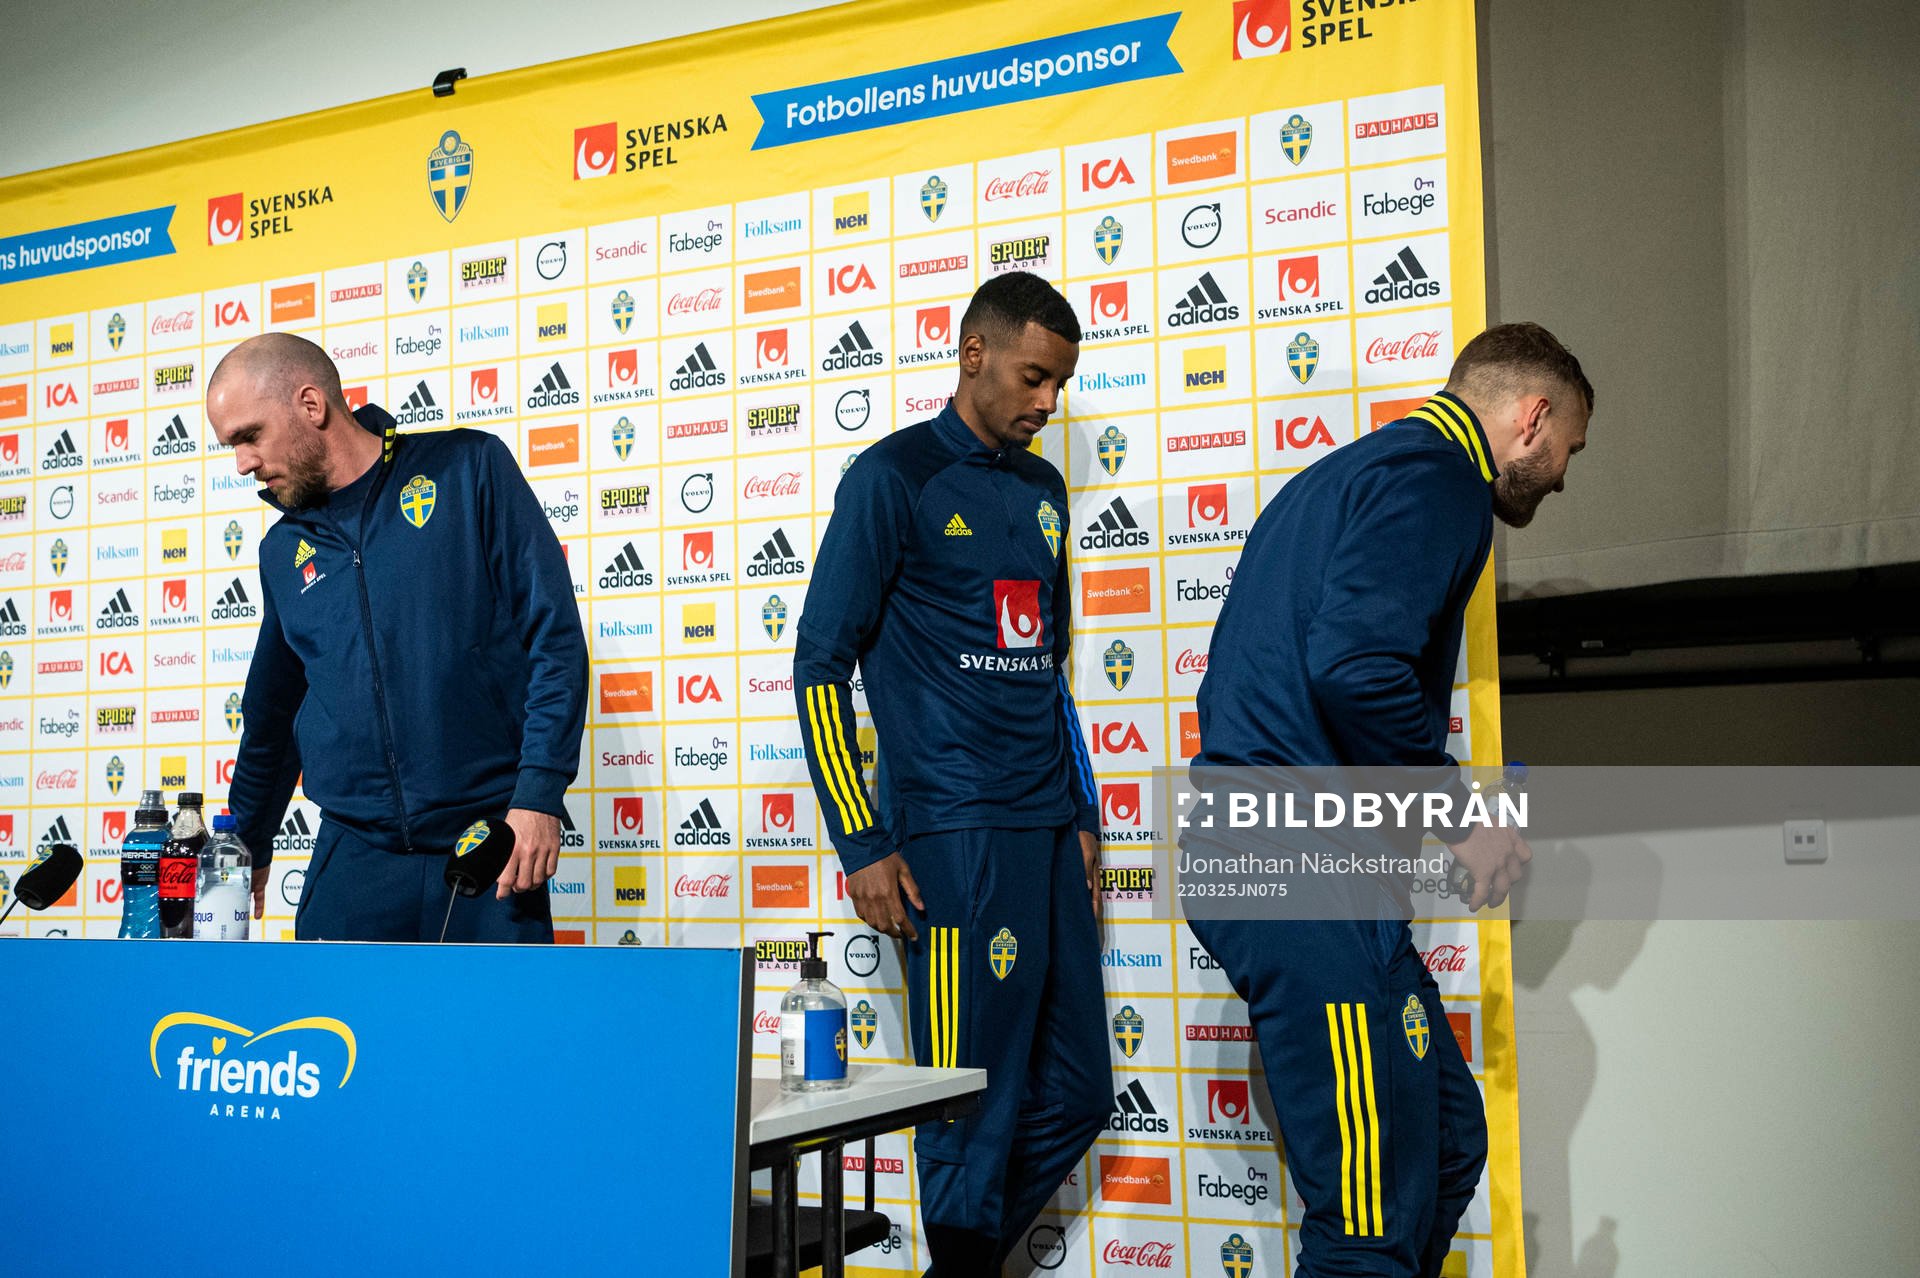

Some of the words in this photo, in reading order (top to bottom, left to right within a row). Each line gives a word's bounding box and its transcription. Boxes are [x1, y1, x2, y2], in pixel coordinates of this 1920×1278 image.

[1302, 17, 1373, 48] SPEL
[786, 80, 926, 128] Fotbollens
[931, 39, 1142, 100] huvudsponsor
[626, 113, 728, 150] SVENSKA
[1356, 112, 1438, 139] BAUHAUS
[625, 146, 678, 173] SPEL
[1171, 152, 1217, 167] Swedbank
[1082, 156, 1135, 193] ICA
[985, 170, 1053, 202] Coca-Cola
[250, 185, 334, 218] SVENSKA
[1363, 192, 1435, 217] Fabege
[1265, 201, 1336, 224] Scandic
[250, 215, 294, 239] SPEL
[745, 218, 802, 239] Folksam
[1187, 221, 1217, 232] VOLVO
[19, 226, 152, 269] huvudsponsor
[595, 240, 648, 261] Scandic
[669, 232, 723, 253] Fabege
[991, 235, 1049, 264] SPORT
[462, 256, 507, 281] SPORT
[899, 255, 968, 278] BAUHAUS
[993, 258, 1047, 272] BLADET
[464, 276, 505, 288] BLADET
[828, 263, 877, 296] ICA
[331, 283, 382, 302] BAUHAUS
[1364, 279, 1441, 304] adidas
[215, 300, 250, 328] ICA
[1168, 304, 1240, 328] adidas
[1258, 305, 1311, 319] SVENSKA
[1315, 301, 1344, 312] SPEL
[459, 324, 509, 343] Folksam
[1124, 324, 1150, 336] SPEL
[332, 342, 378, 361] Scandic
[396, 337, 442, 356] Fabege
[1365, 331, 1443, 365] Coca-Cola
[822, 351, 883, 371] adidas
[898, 351, 944, 365] SVENSKA
[154, 364, 194, 386] SPORT
[670, 372, 726, 391] adidas
[740, 372, 782, 385] SVENSKA
[784, 368, 807, 380] SPEL
[1078, 372, 1146, 392] Folksam
[46, 383, 79, 409] ICA
[93, 378, 139, 396] BAUHAUS
[593, 390, 632, 404] SVENSKA
[634, 387, 655, 399] SPEL
[527, 390, 580, 409] adidas
[395, 408, 444, 426] adidas
[457, 407, 493, 421] SVENSKA
[495, 405, 515, 416] SPEL
[748, 404, 800, 430] SPORT
[840, 405, 867, 414] VOLVO
[667, 419, 729, 439] BAUHAUS
[750, 425, 798, 437] BLADET
[1275, 415, 1337, 451] ICA
[152, 440, 196, 457] adidas
[1167, 430, 1246, 452] BAUHAUS
[42, 453, 83, 471] adidas
[212, 476, 256, 491] Folksam
[97, 490, 138, 505] Scandic
[154, 485, 195, 504] Fabege
[601, 485, 650, 508] SPORT
[0, 495, 26, 514] PORT
[544, 501, 579, 522] bege
[603, 507, 648, 517] BLADET
[944, 527, 972, 536] adidas
[1079, 530, 1150, 550] adidas
[1168, 531, 1221, 545] SVENSKA
[97, 546, 139, 561] Folksam
[746, 560, 805, 578] adidas
[599, 572, 653, 590] adidas
[667, 575, 708, 586] SVENSKA
[709, 572, 731, 583] SPEL
[1087, 586, 1131, 599] Swedbank
[96, 613, 139, 629] adidas
[211, 603, 257, 620] adidas
[599, 621, 653, 638] Folksam
[37, 660, 83, 674] BAUHAUS
[100, 651, 134, 676] ICA
[154, 652, 197, 668] Scandic
[960, 653, 1039, 672] SVENSKA
[604, 687, 639, 699] Swedbank
[678, 674, 723, 704] ICA
[749, 675, 793, 693] Scand
[97, 706, 137, 726] SPORT
[151, 709, 200, 723] BAUHAUS
[39, 718, 80, 738] Fabege
[1091, 721, 1149, 754] ICA
[602, 750, 655, 767] Scandic
[675, 746, 728, 771] Fabege
[271, 834, 316, 852] adidas
[599, 840, 637, 849] SVENSKA
[640, 839, 661, 849] SPEL
[674, 829, 731, 846] adidas
[746, 838, 788, 848] SVENSKA
[791, 837, 813, 848] SPEL
[1098, 831, 1133, 842] ENSKA
[1136, 830, 1163, 841] SPEL
[548, 879, 585, 894] lksam
[674, 873, 734, 899] Coca-Cola
[756, 882, 793, 892] Swedbank
[1106, 891, 1154, 900] LADET
[756, 940, 808, 962] SPORT
[1101, 948, 1162, 967] olksam
[758, 962, 798, 970] BLADE
[1186, 1024, 1254, 1041] BAUHAU
[177, 1046, 320, 1098] friends
[209, 1103, 281, 1120] ARENA
[1188, 1128, 1242, 1140] SVENSKA
[1245, 1130, 1274, 1142] SPEL
[1105, 1173, 1151, 1185] Swedbank
[1198, 1173, 1268, 1206] Fabege
[1103, 1238, 1176, 1269] Coca-Cola
